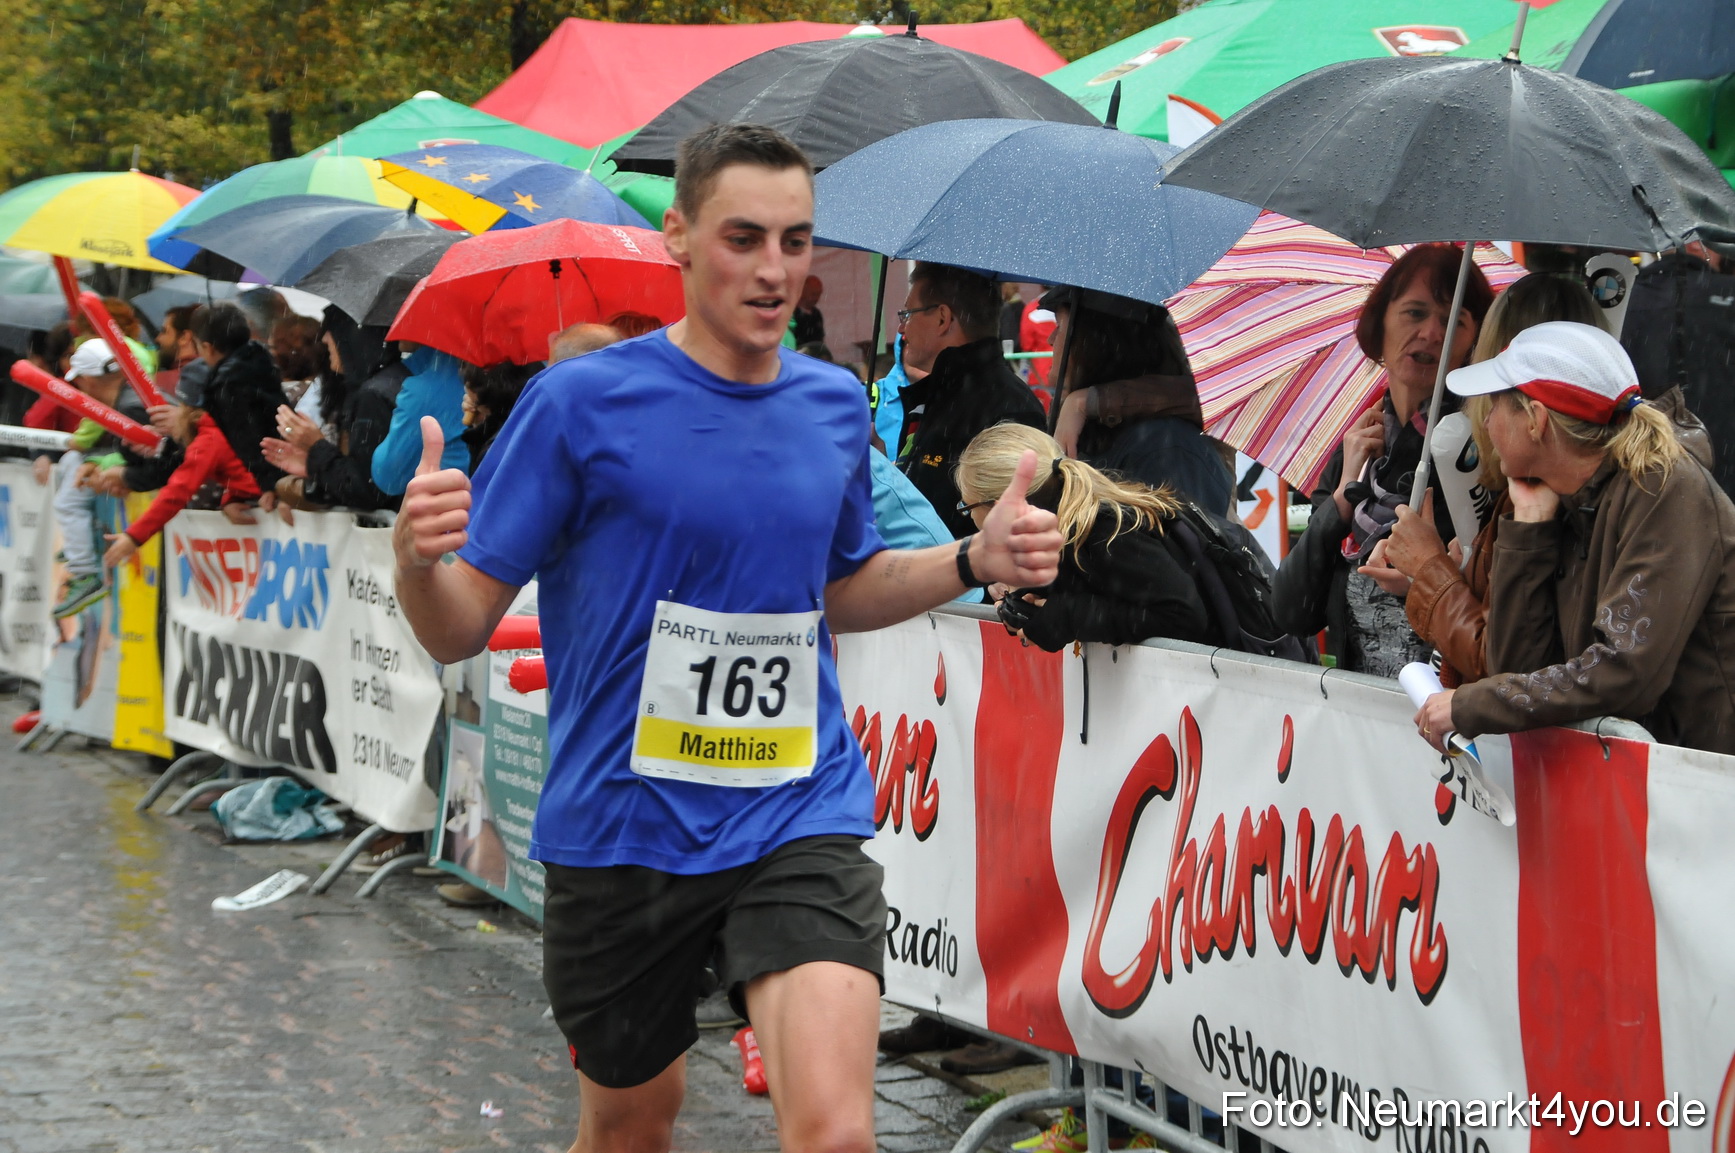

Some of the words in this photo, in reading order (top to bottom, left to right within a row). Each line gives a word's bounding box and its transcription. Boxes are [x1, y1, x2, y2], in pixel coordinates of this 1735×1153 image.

[657, 618, 720, 646] PARTL
[724, 631, 802, 646] Neumarkt
[689, 655, 791, 719] 163
[679, 731, 778, 761] Matthias
[1082, 704, 1456, 1018] Charivari
[885, 906, 958, 978] Radio
